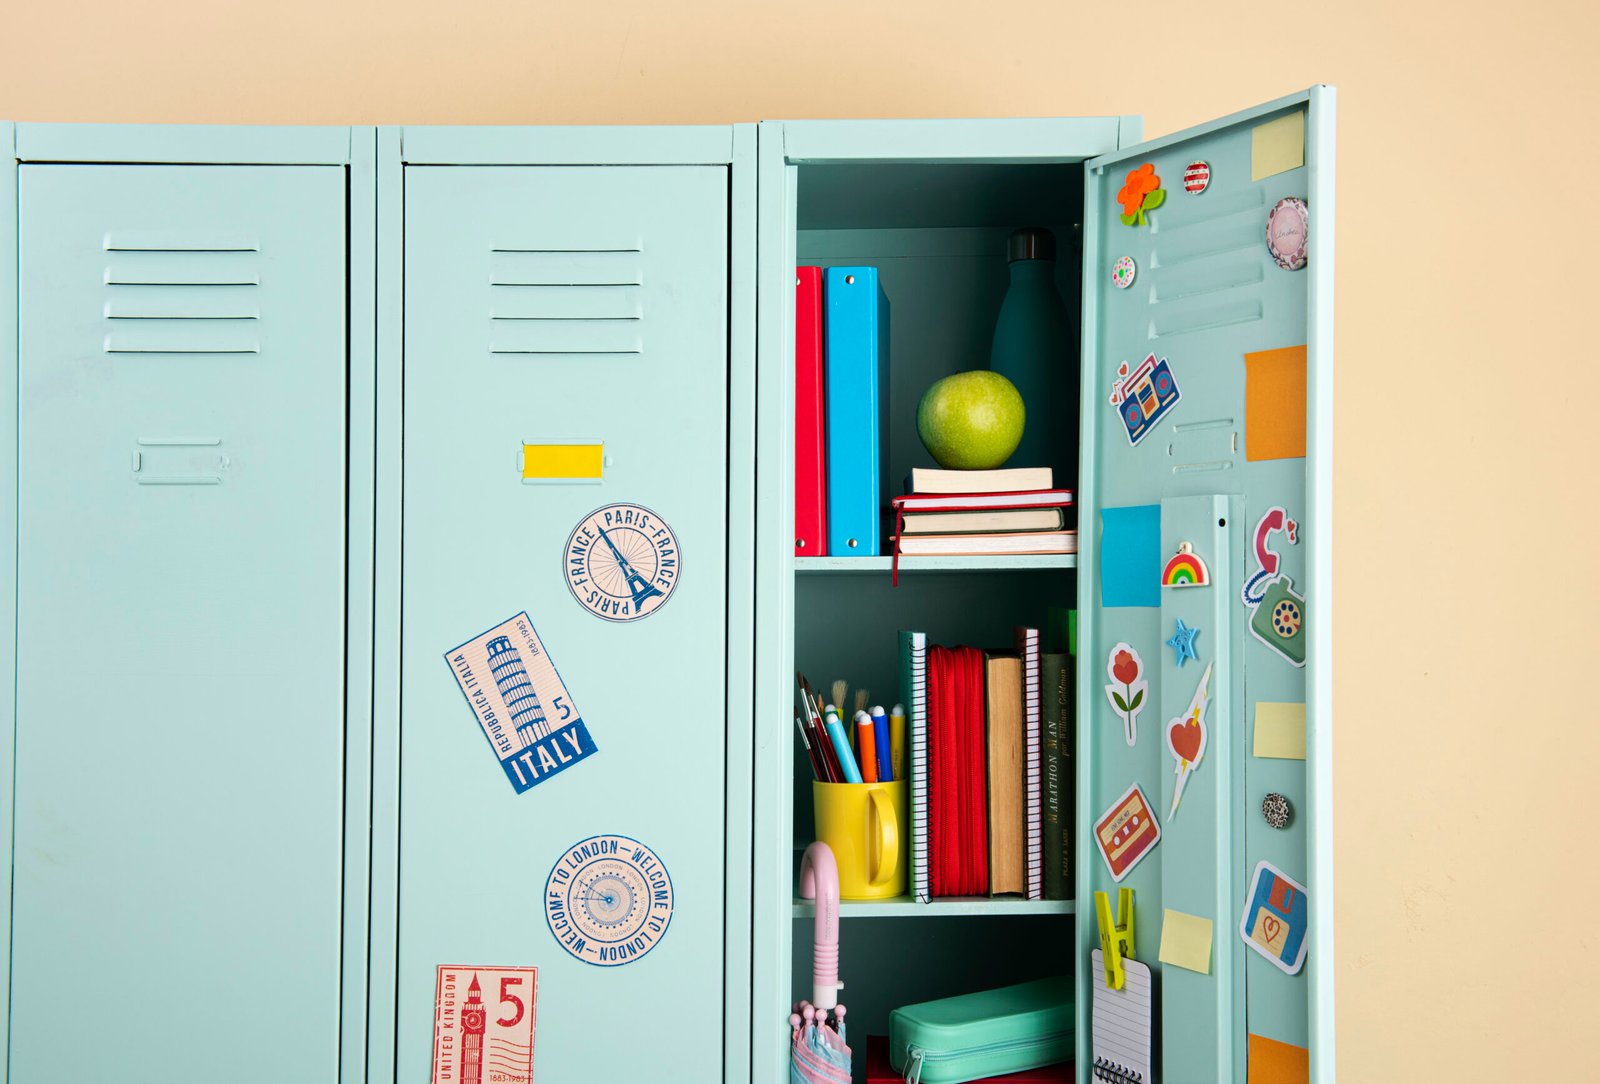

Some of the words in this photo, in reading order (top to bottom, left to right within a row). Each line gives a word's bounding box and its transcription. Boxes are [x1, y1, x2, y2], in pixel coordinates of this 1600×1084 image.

[453, 653, 479, 689] ITALIA
[472, 688, 513, 753] REPUBBLICA
[552, 696, 571, 720] 5
[510, 726, 583, 786] ITALY
[1047, 720, 1058, 750] MAN
[1048, 756, 1059, 824] MARATHON
[552, 868, 570, 885] TO
[647, 915, 666, 932] TO
[443, 974, 456, 1029] KINGDOM
[496, 977, 525, 1027] 5
[441, 1035, 453, 1080] UNITED
